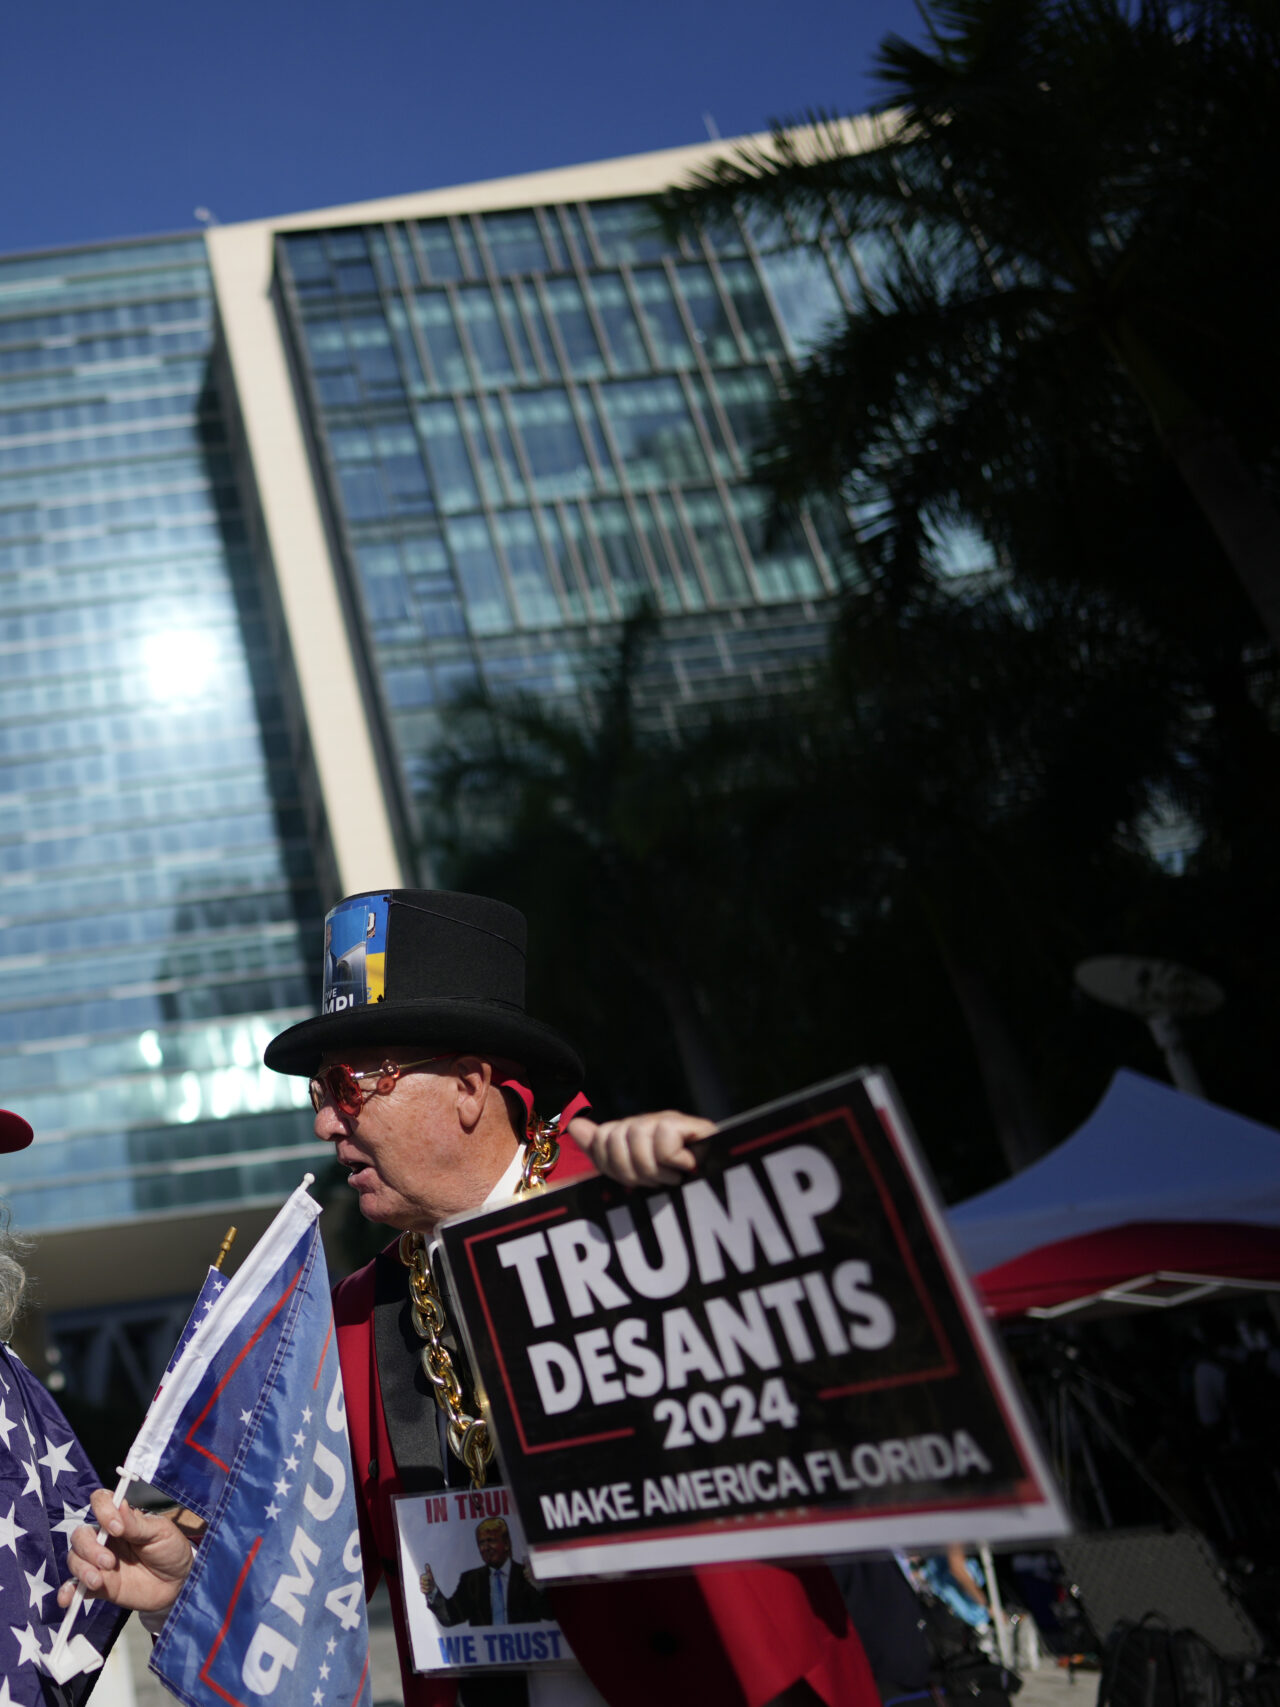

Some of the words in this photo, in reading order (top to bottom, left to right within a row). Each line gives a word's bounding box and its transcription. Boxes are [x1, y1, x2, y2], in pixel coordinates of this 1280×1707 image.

[497, 1144, 842, 1328] TRUMP
[526, 1260, 896, 1416] DESANTIS
[653, 1377, 799, 1450] 2024
[424, 1496, 449, 1524] IN
[539, 1483, 640, 1531] MAKE
[642, 1456, 808, 1517] AMERICA
[803, 1430, 993, 1494] FLORIDA
[438, 1635, 477, 1665] WE
[483, 1629, 562, 1663] TRUST
